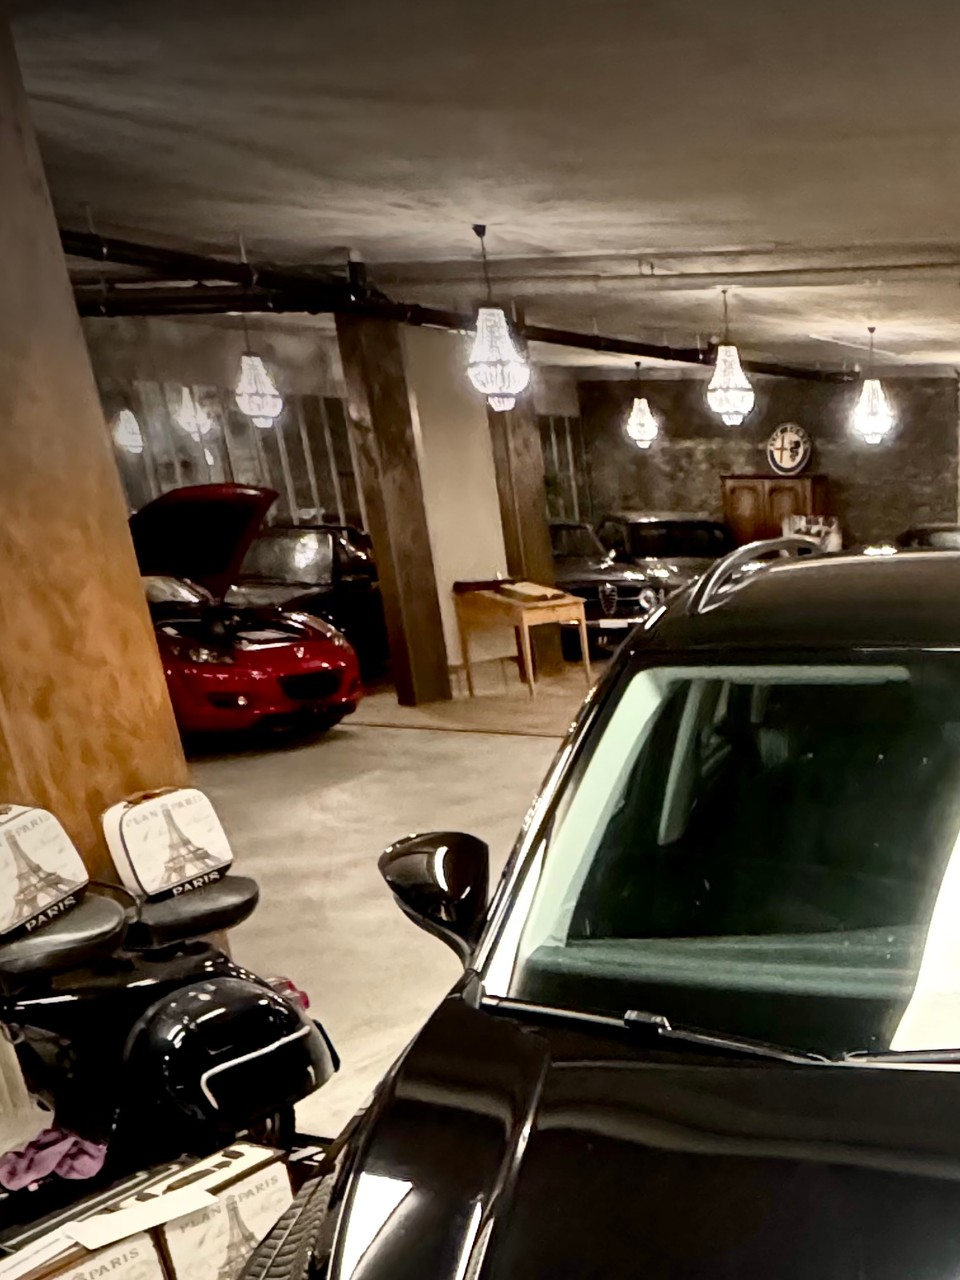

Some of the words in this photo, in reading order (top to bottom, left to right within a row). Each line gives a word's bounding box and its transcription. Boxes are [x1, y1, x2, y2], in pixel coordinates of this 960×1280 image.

[172, 871, 220, 896] PARIS
[25, 896, 77, 932] PARIS
[238, 1175, 279, 1203] PARIS
[88, 1247, 140, 1280] PARIS
